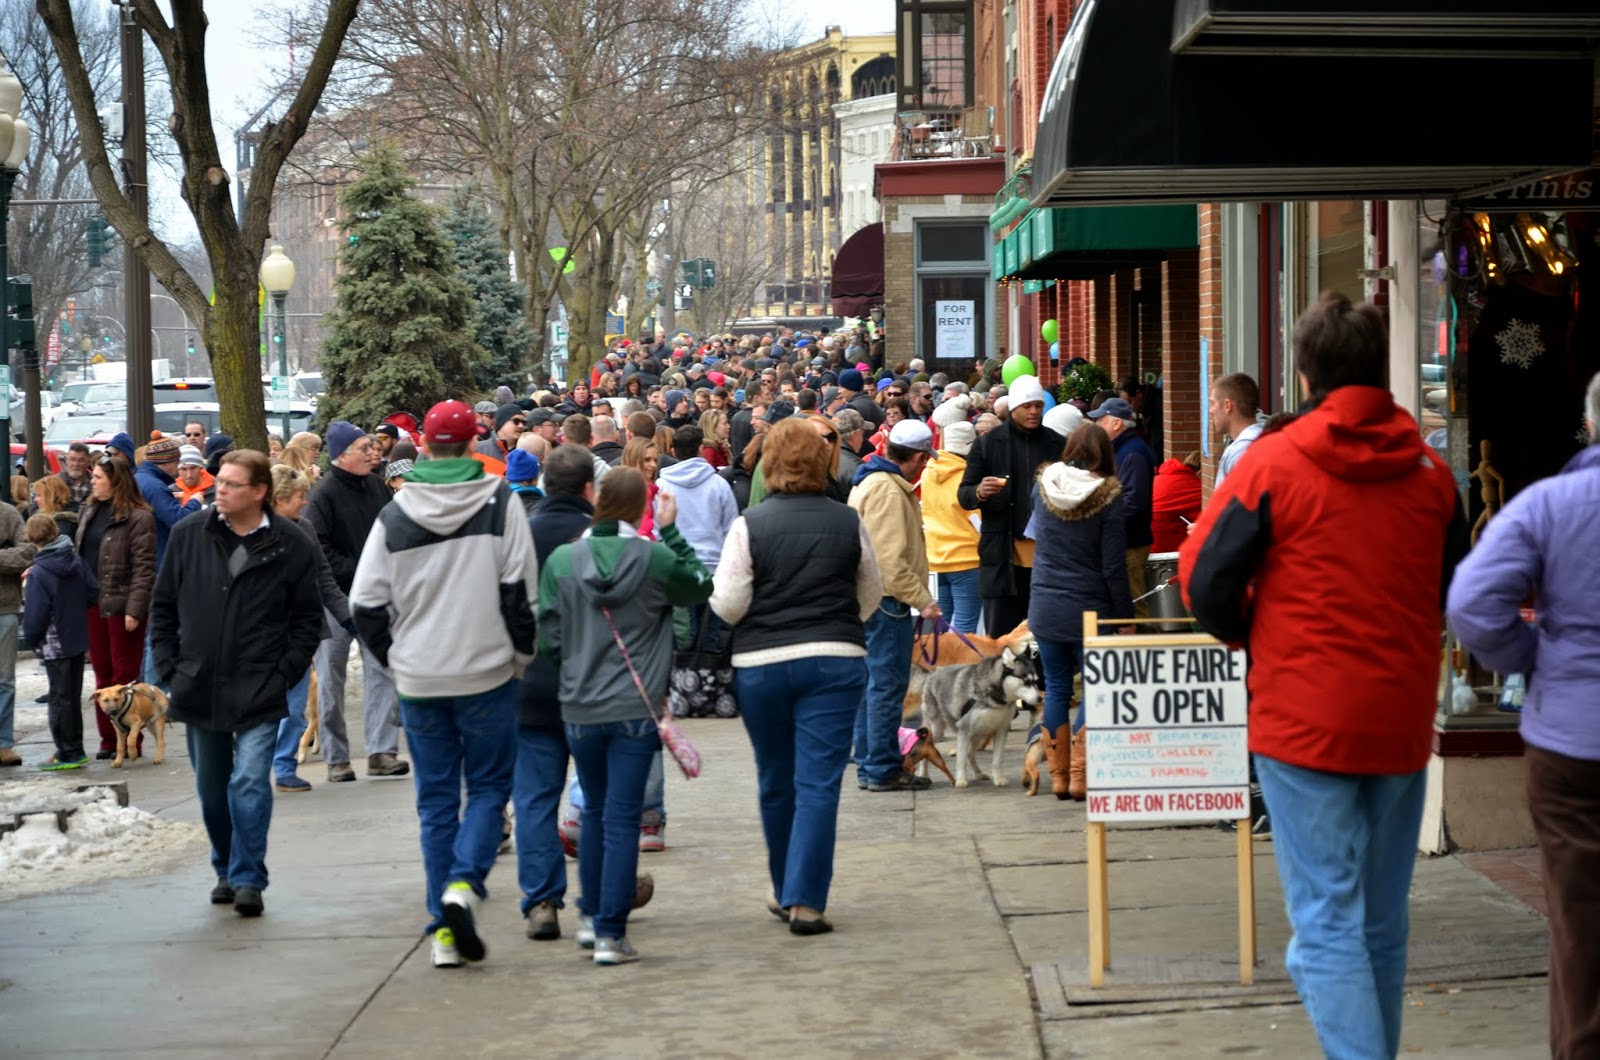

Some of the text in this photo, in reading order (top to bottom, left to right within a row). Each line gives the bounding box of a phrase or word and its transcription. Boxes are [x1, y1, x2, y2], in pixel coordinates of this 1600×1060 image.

[944, 305, 967, 313] FOR
[938, 317, 972, 326] RENT
[1084, 648, 1241, 685] SOAVE FAIRE
[1112, 687, 1225, 725] IS OPEN
[1129, 732, 1152, 744] ART
[1089, 792, 1244, 814] WE ARE ON FACEBOOK
